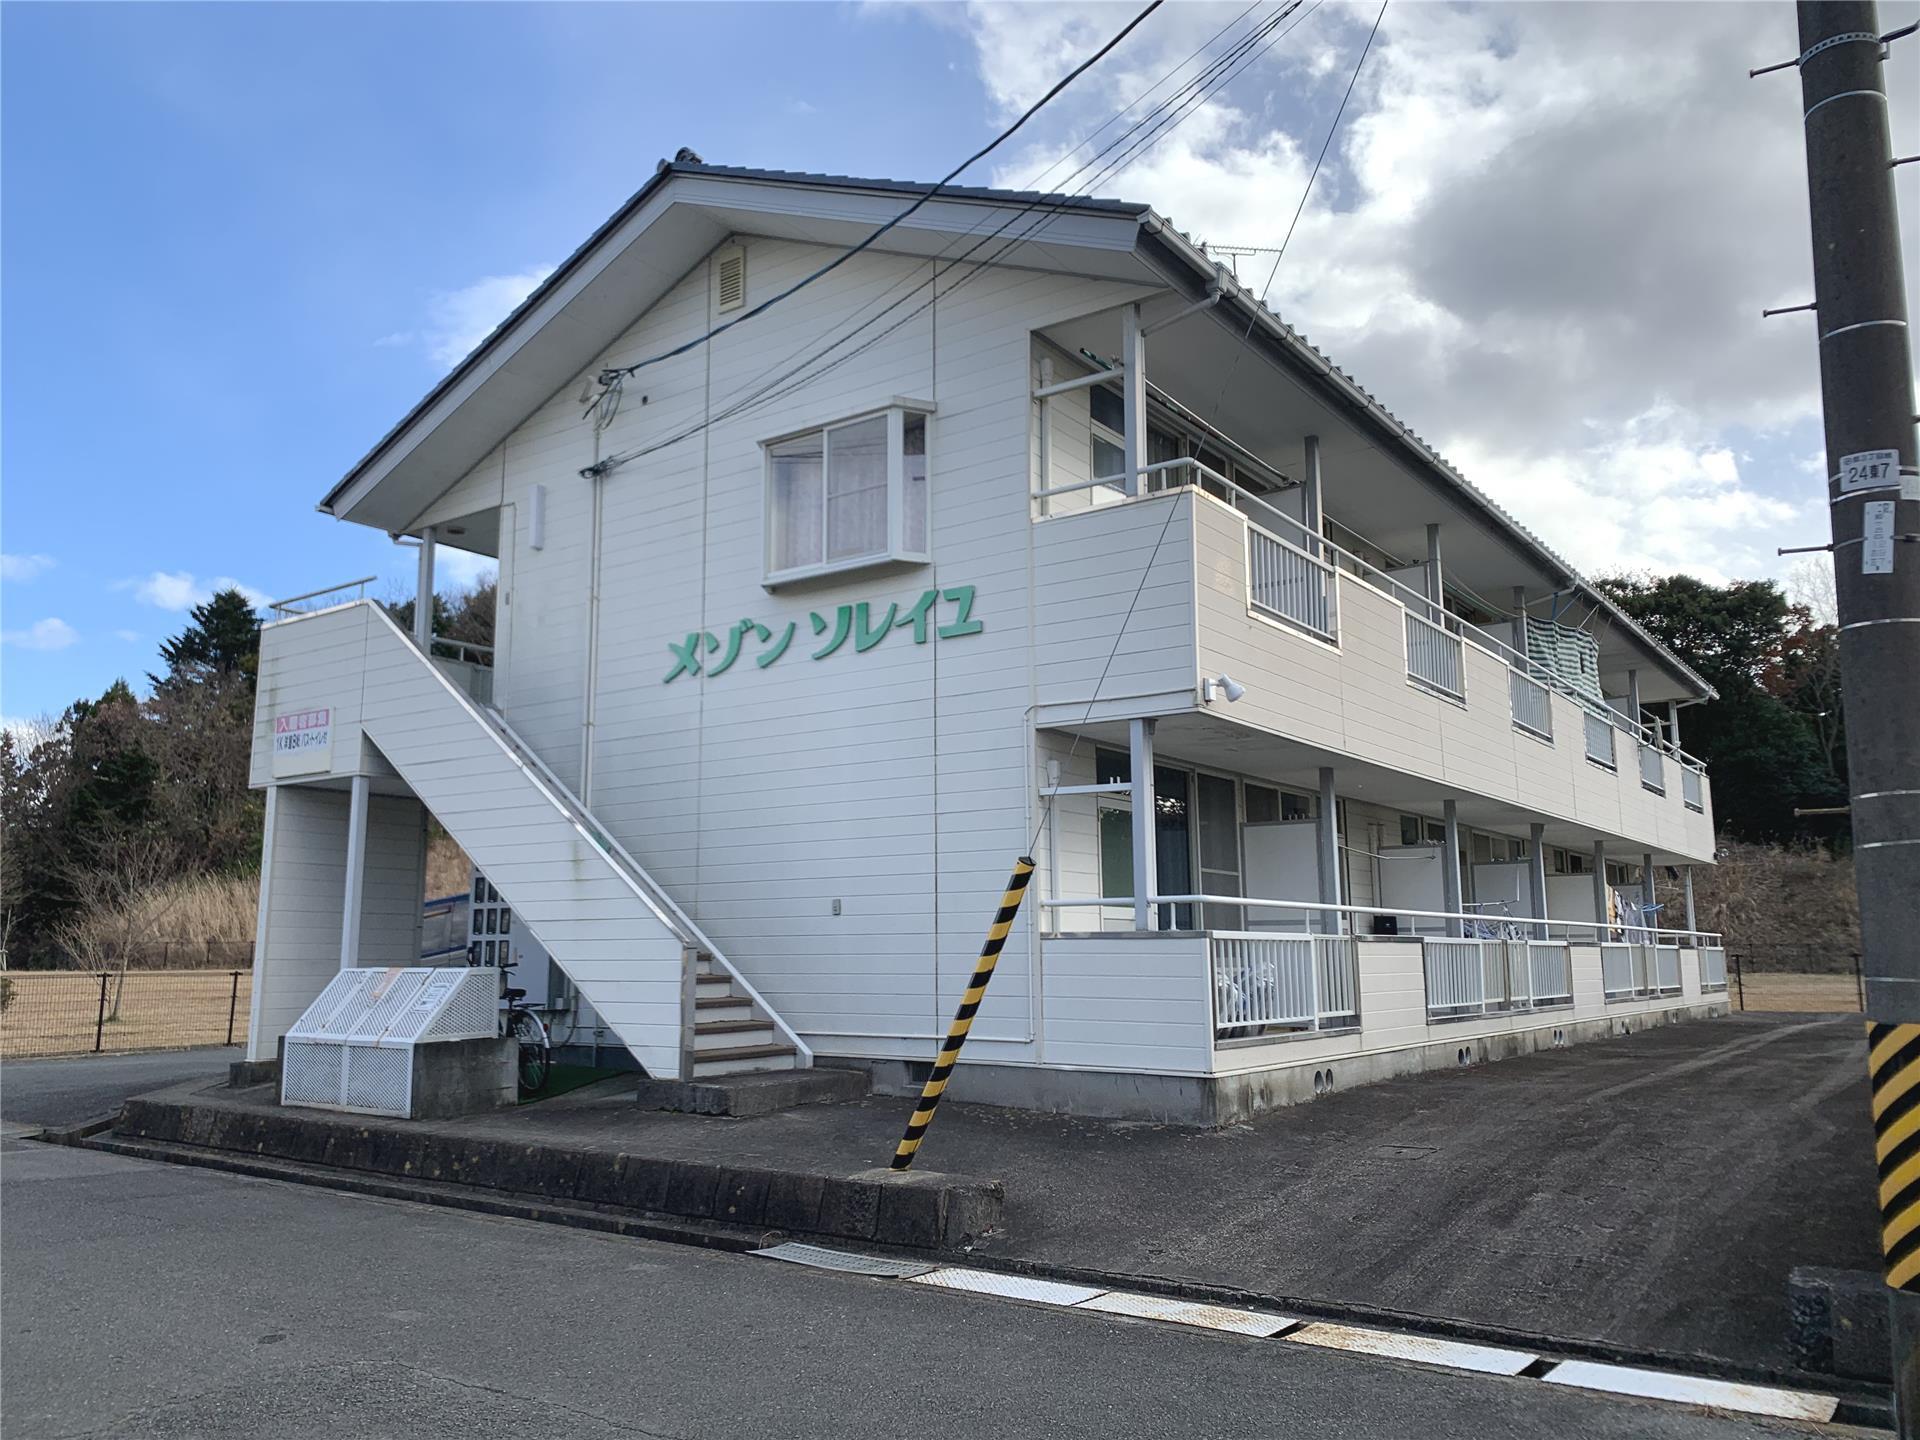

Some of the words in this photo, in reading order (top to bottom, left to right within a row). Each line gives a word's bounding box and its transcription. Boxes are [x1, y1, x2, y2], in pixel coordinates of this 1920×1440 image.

[663, 618, 796, 684] メゾン
[810, 585, 983, 661] ソレイユ
